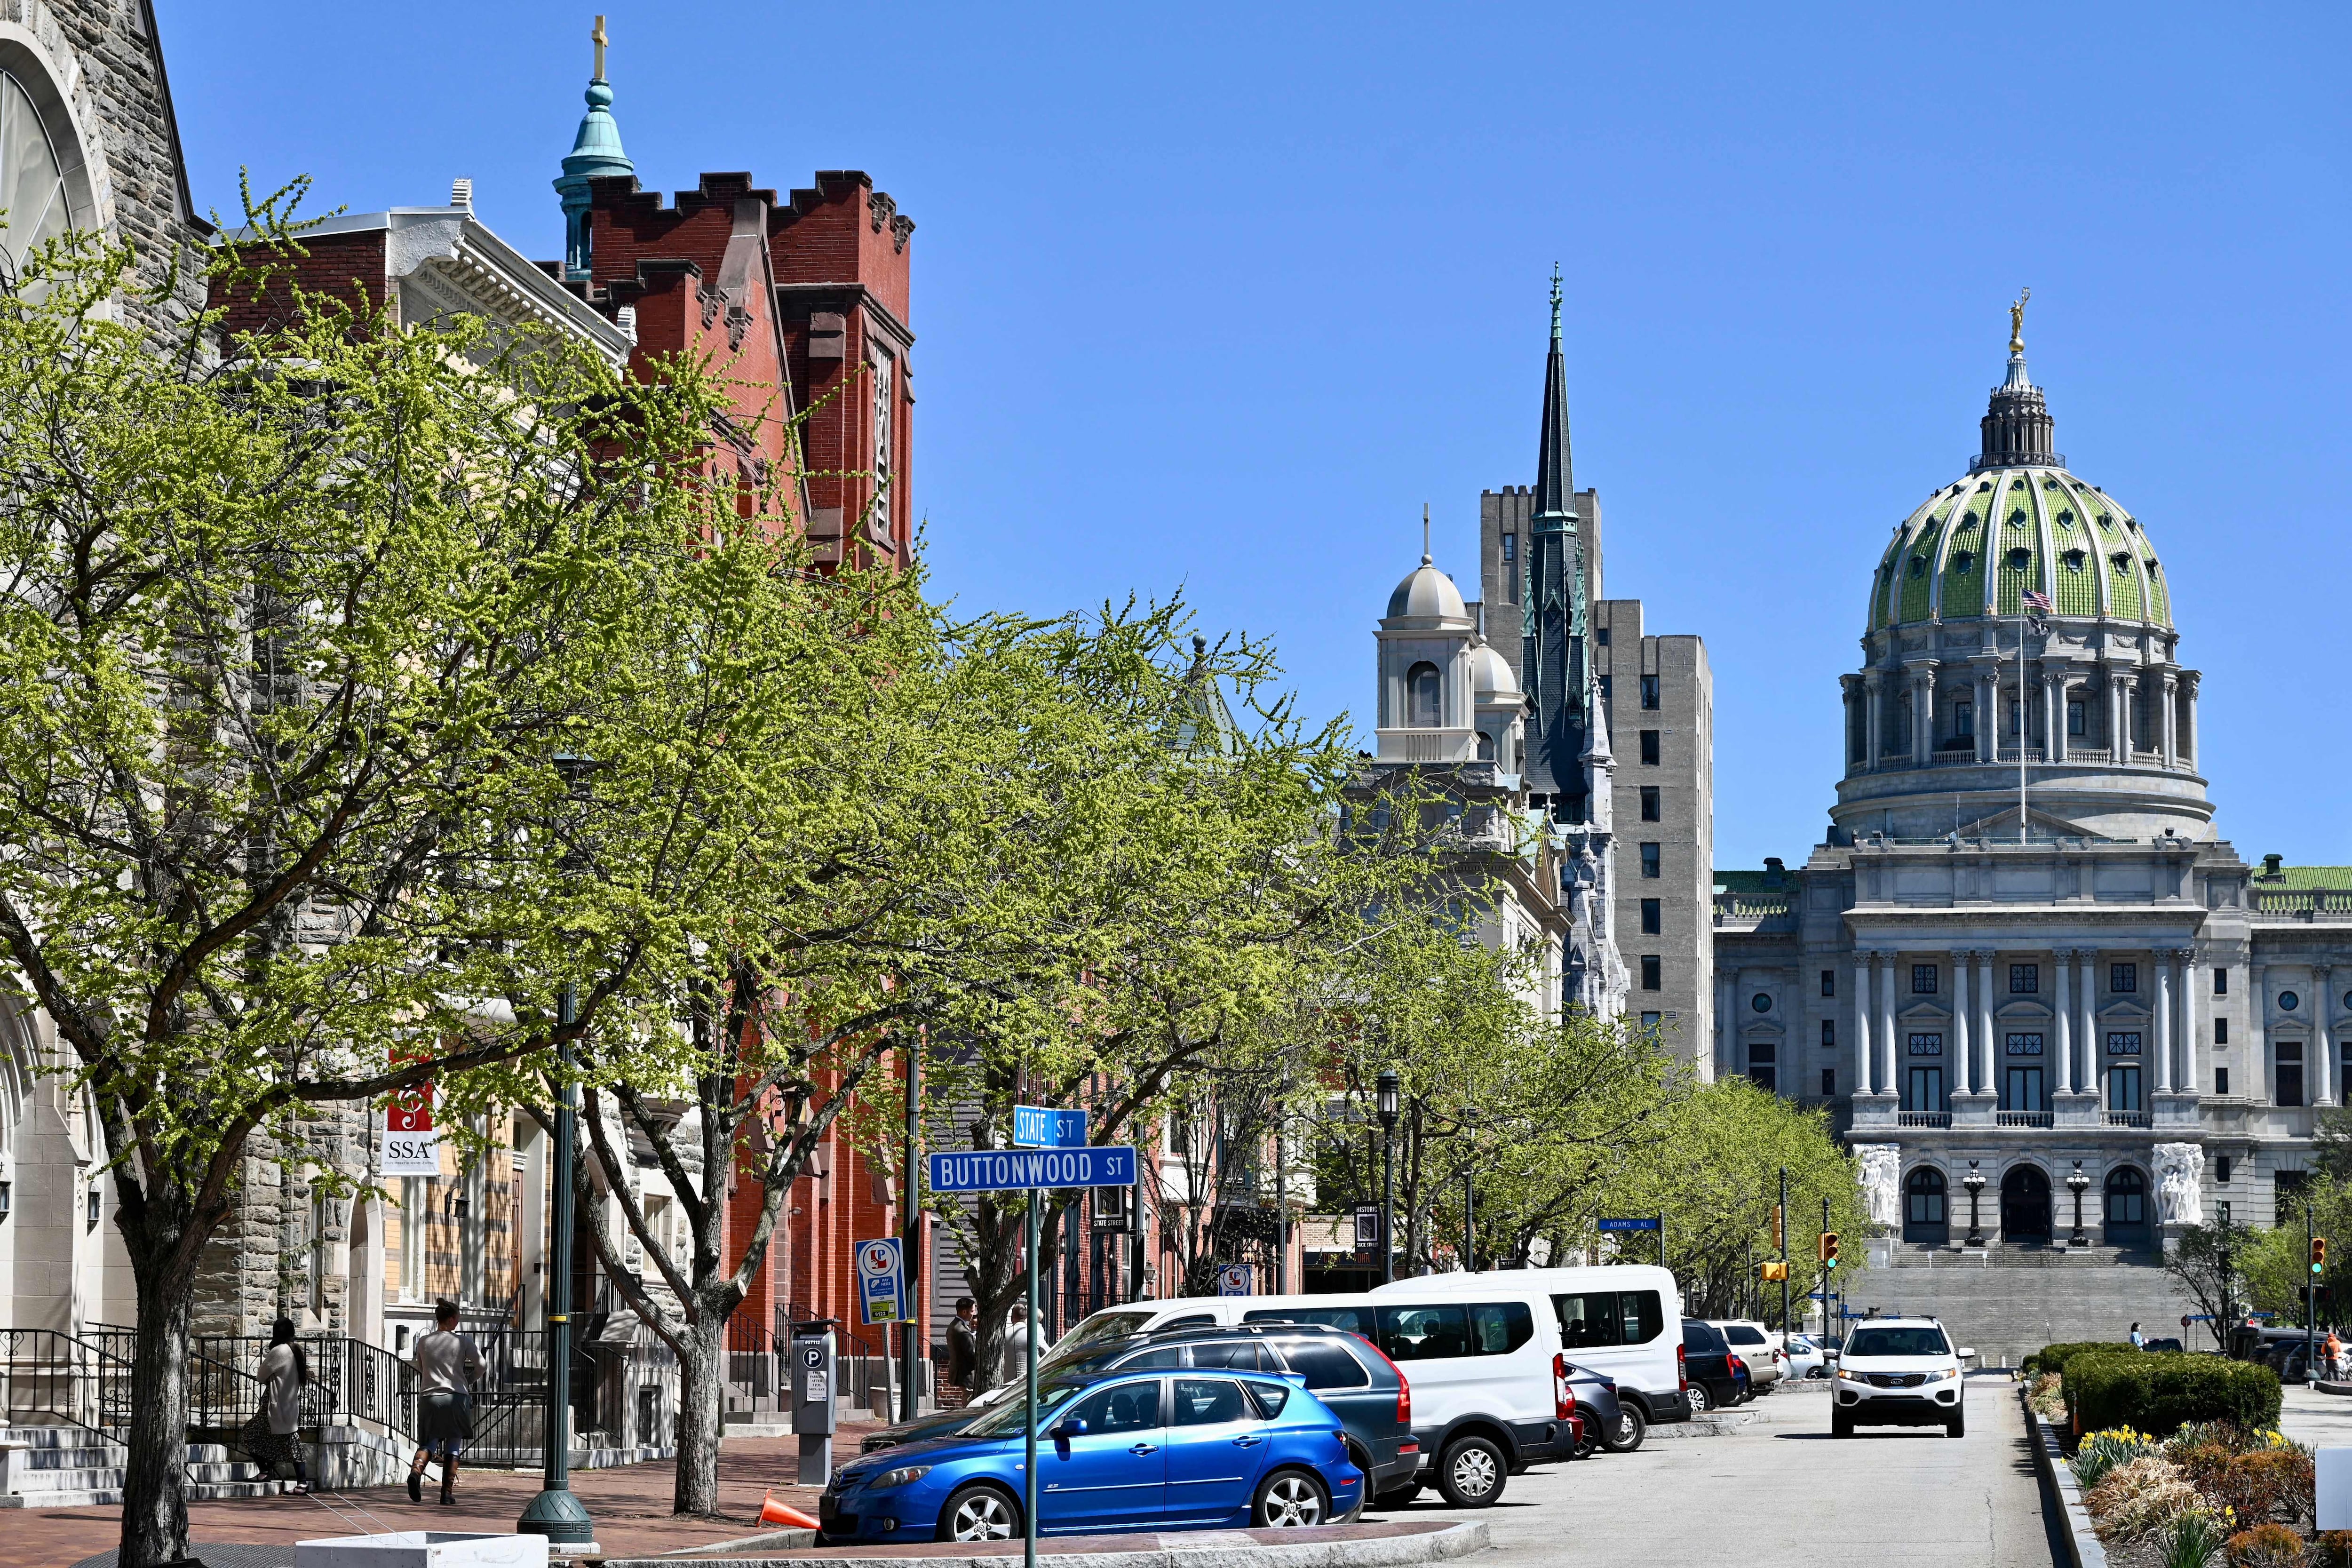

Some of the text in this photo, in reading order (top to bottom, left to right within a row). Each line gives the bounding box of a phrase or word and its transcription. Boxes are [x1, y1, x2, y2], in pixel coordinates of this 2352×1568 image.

[1019, 1111, 1074, 1142] STATE ST
[389, 1141, 430, 1158] SSA
[941, 1153, 1123, 1186] BUTTONWOOD ST
[1354, 1253, 1370, 1263] FORK
[809, 1351, 818, 1365] P
